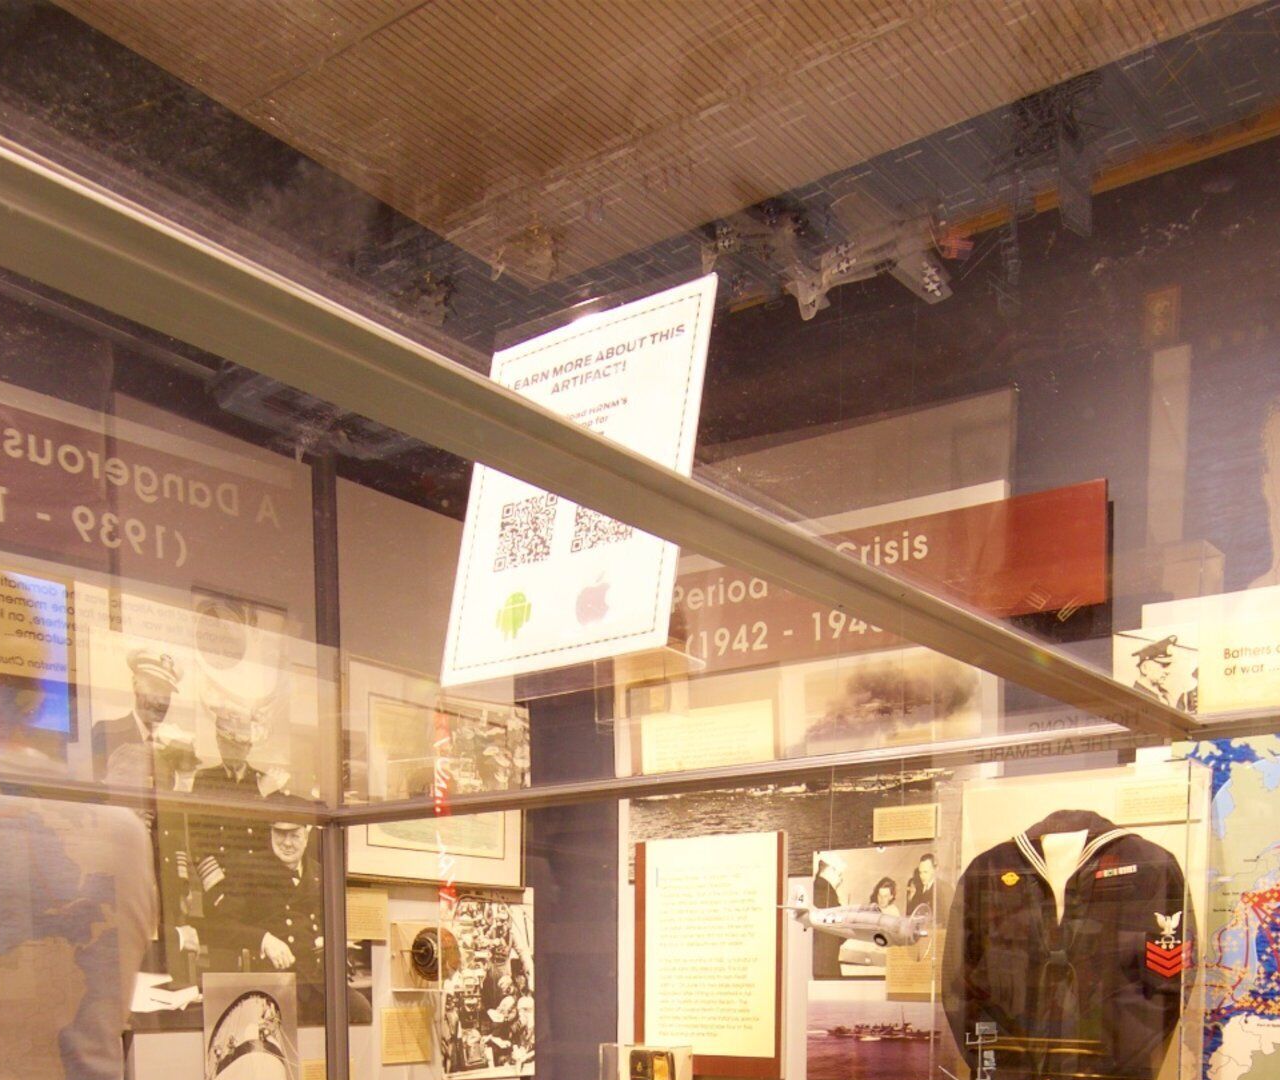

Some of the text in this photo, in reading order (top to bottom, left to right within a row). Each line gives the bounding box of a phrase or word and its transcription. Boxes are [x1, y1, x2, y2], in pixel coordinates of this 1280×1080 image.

[552, 354, 592, 379] MORE
[595, 337, 647, 362] ABOUT
[650, 324, 686, 345] THIS
[551, 360, 628, 394] ARTIFACT!
[1224, 664, 1236, 677] of
